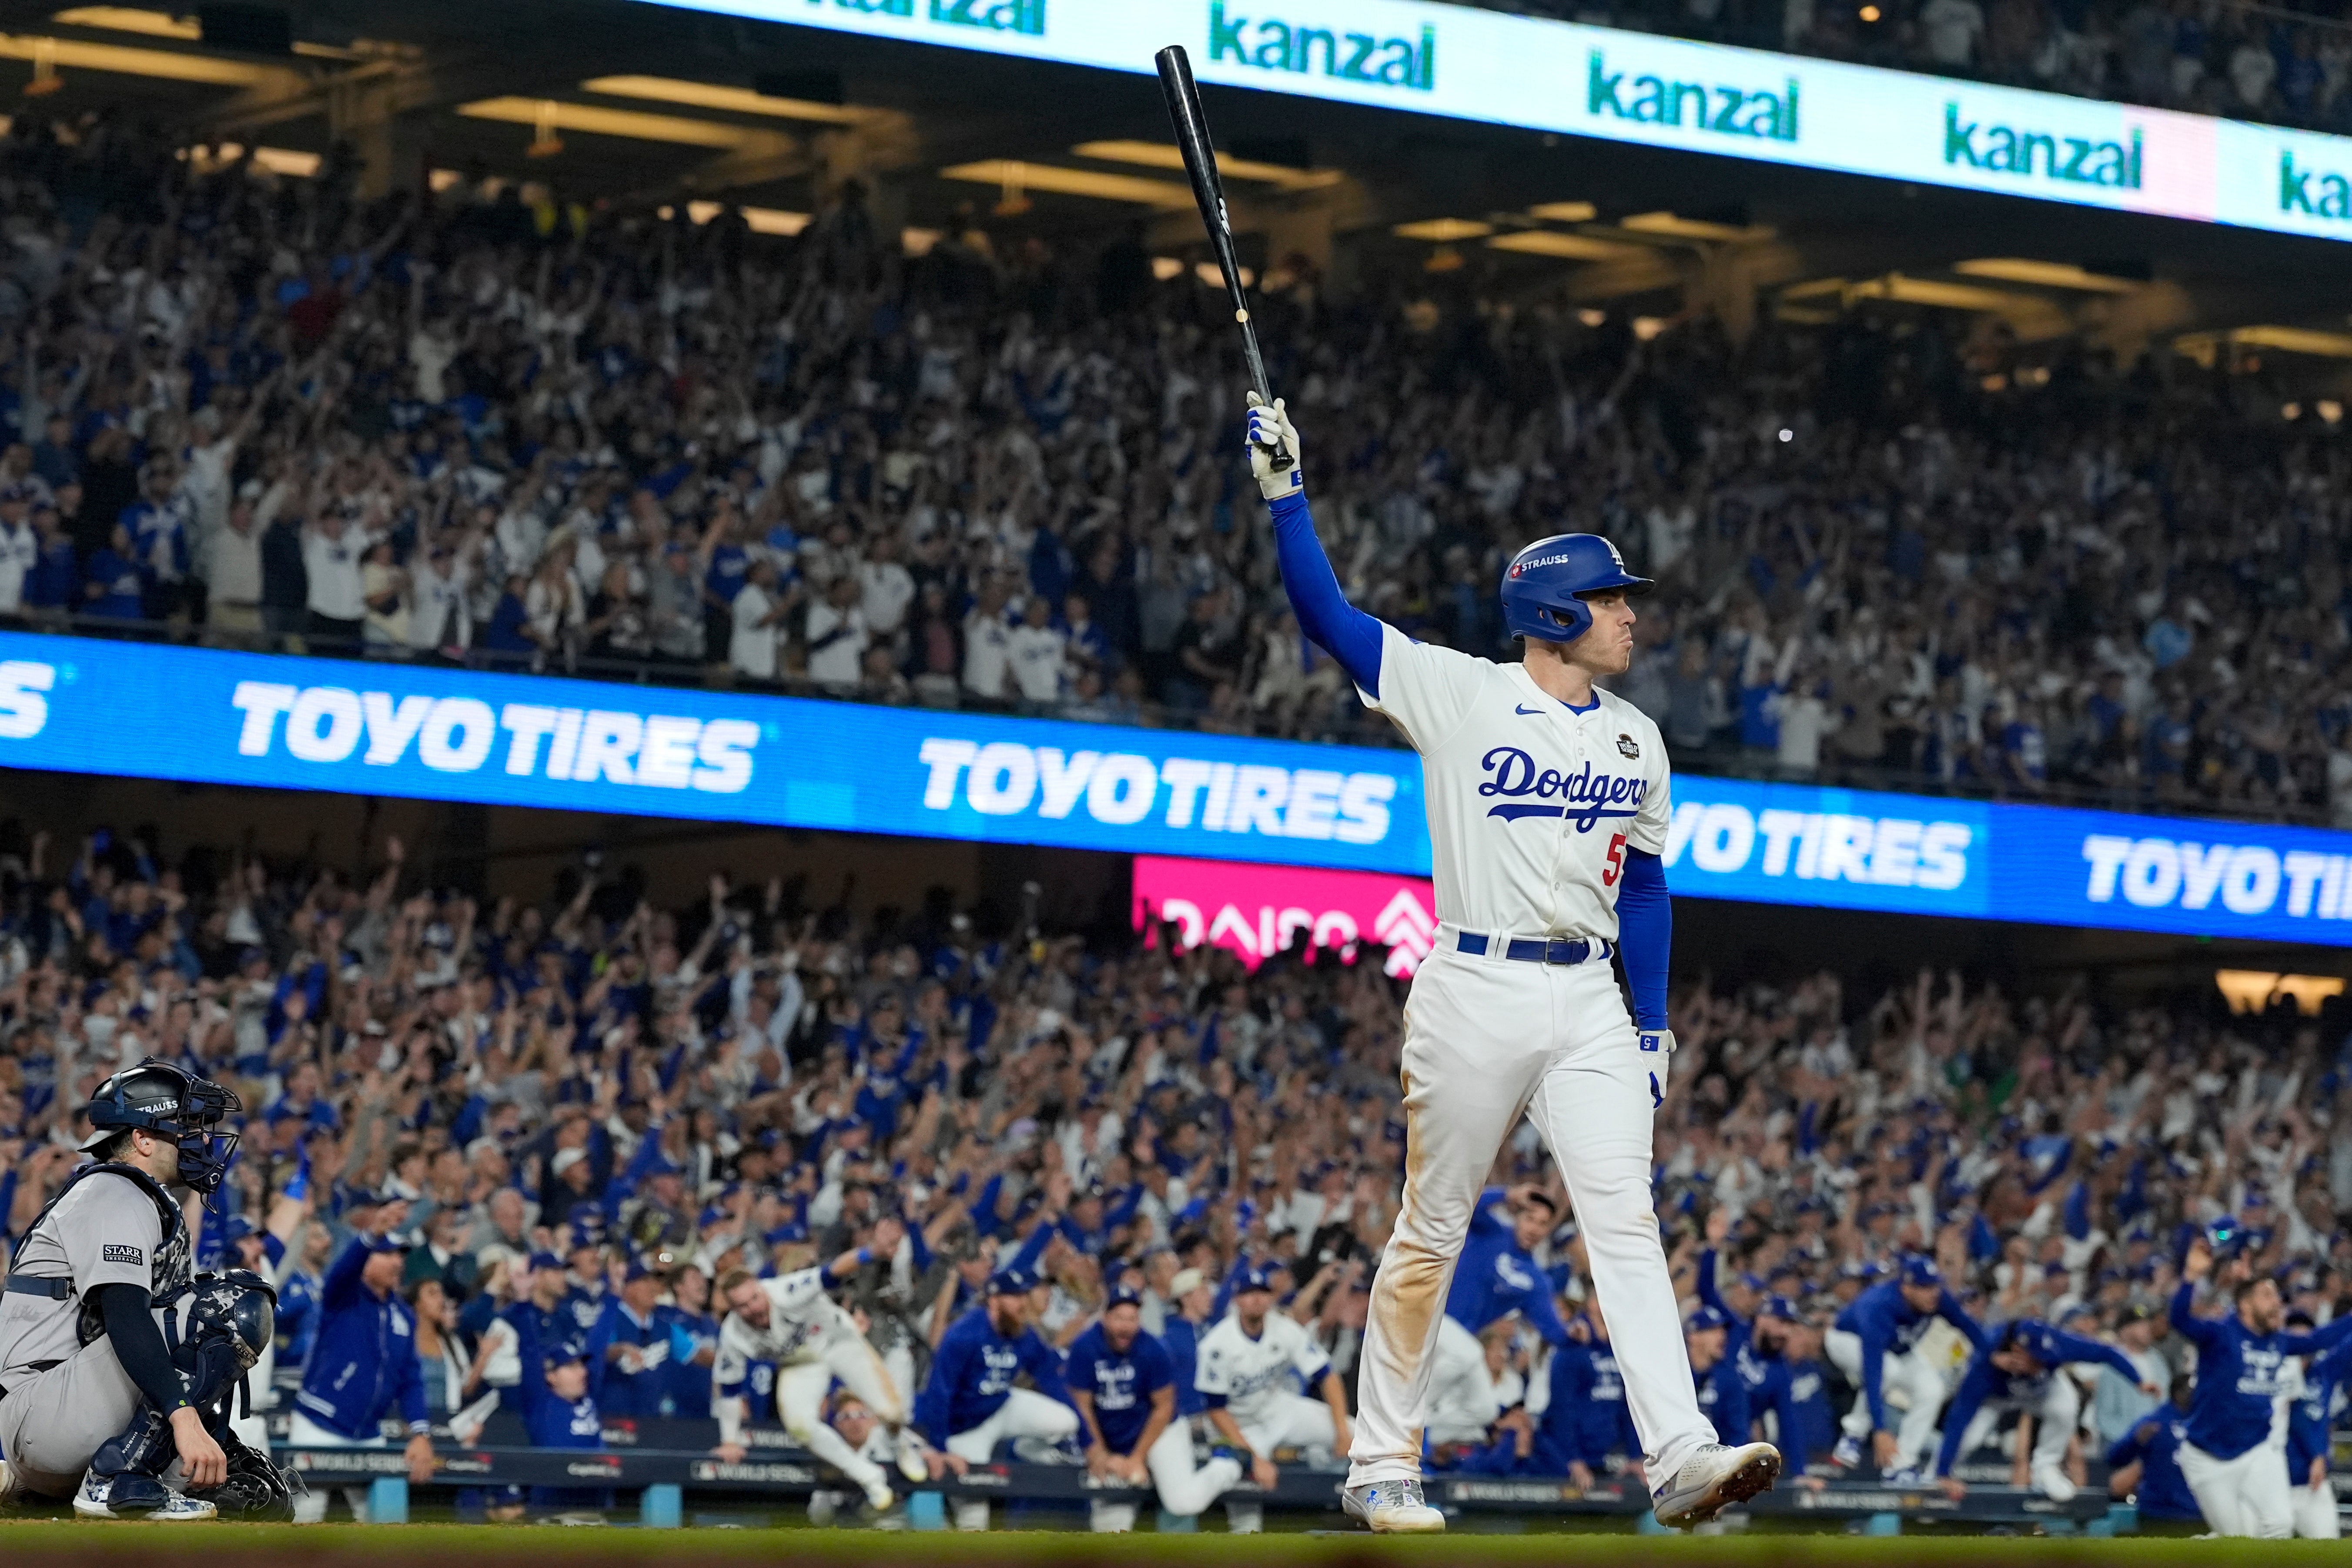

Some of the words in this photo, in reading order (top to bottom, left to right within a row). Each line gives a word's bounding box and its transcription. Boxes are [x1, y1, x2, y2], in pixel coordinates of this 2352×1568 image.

[1297, 471, 1303, 483] 5
[1522, 554, 1569, 572] STRAUSS
[233, 682, 495, 772] TOYO
[500, 703, 759, 793] TIRES
[919, 738, 1158, 825] TOYO
[1160, 758, 1397, 844] TIRES
[1603, 833, 1626, 886] 5
[1757, 809, 1971, 890] TIRES
[2083, 834, 2281, 914] TOYO
[2283, 852, 2352, 920] TI
[1644, 1037, 1651, 1049] 5
[134, 1100, 178, 1113] TRAUSS
[105, 1246, 141, 1258] STARR
